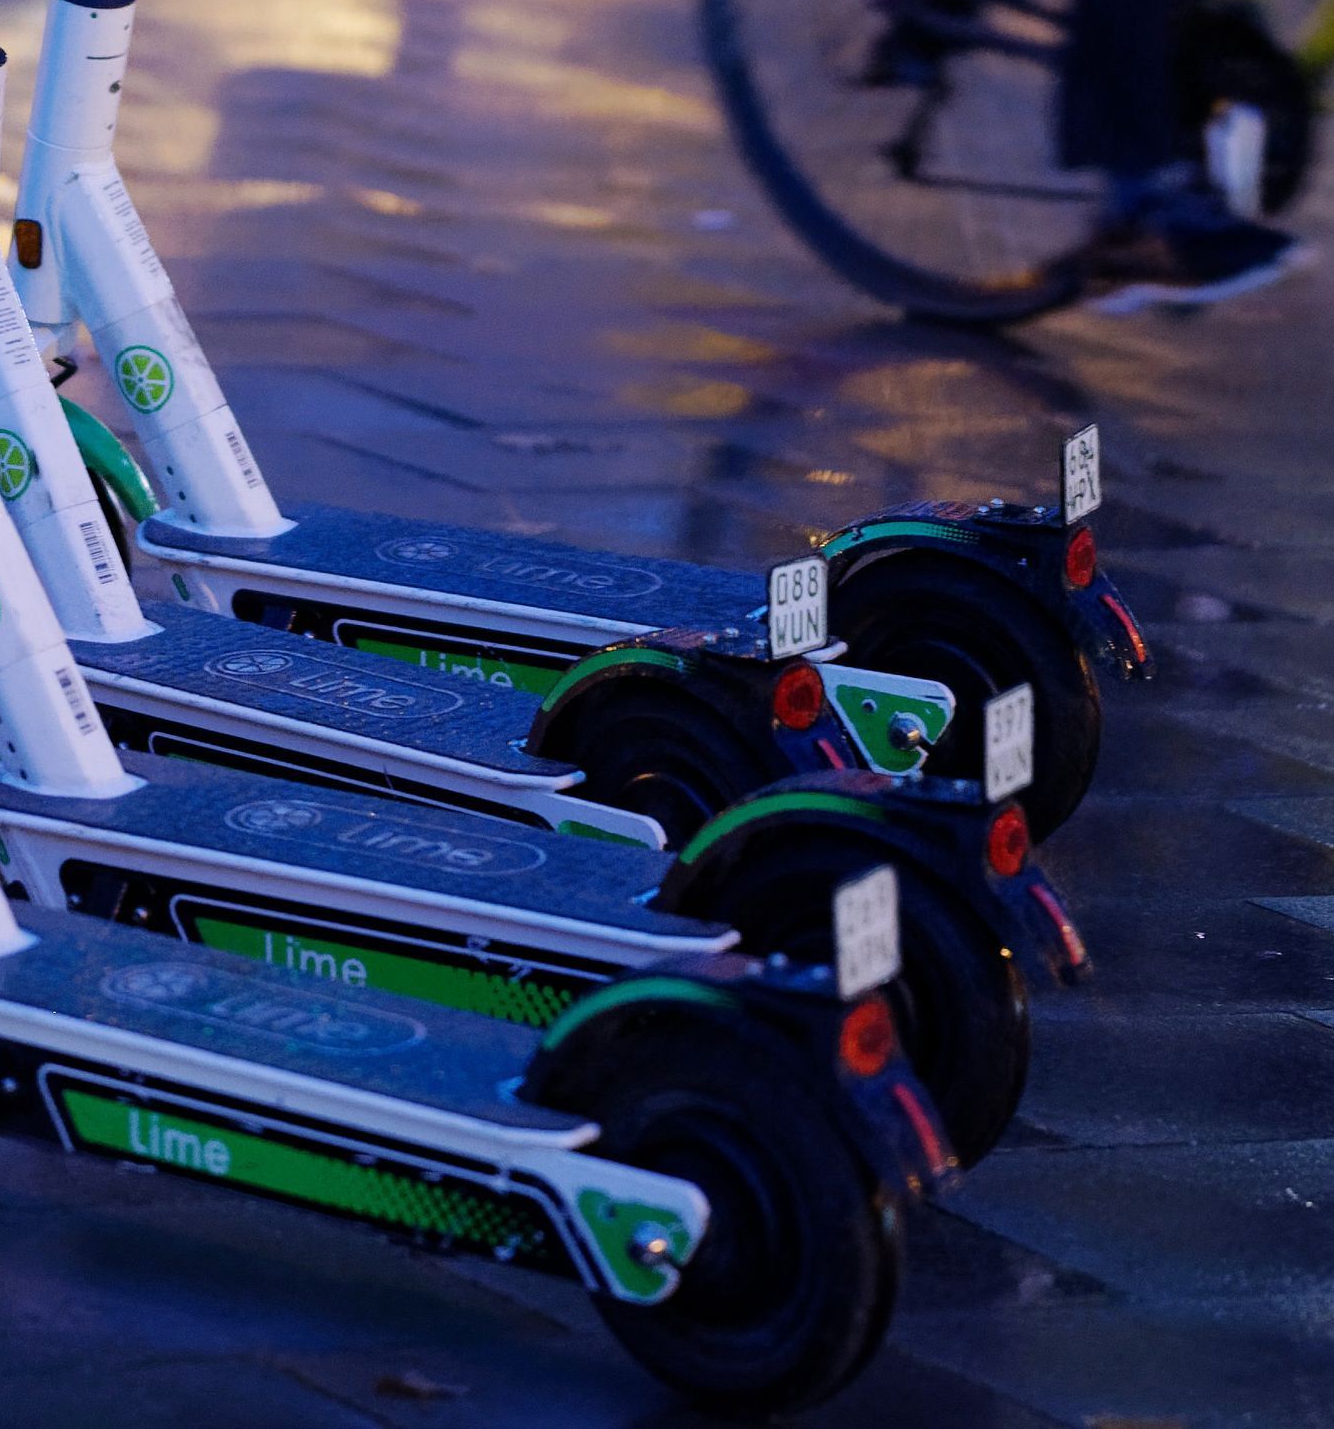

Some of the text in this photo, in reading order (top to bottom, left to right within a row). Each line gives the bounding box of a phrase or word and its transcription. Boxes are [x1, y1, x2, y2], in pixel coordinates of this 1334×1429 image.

[475, 555, 615, 589] Lime
[777, 566, 818, 605] 088
[776, 607, 819, 648] WUN
[289, 670, 416, 709] Lime
[337, 822, 493, 866] Lime
[129, 1107, 231, 1175] Lime
